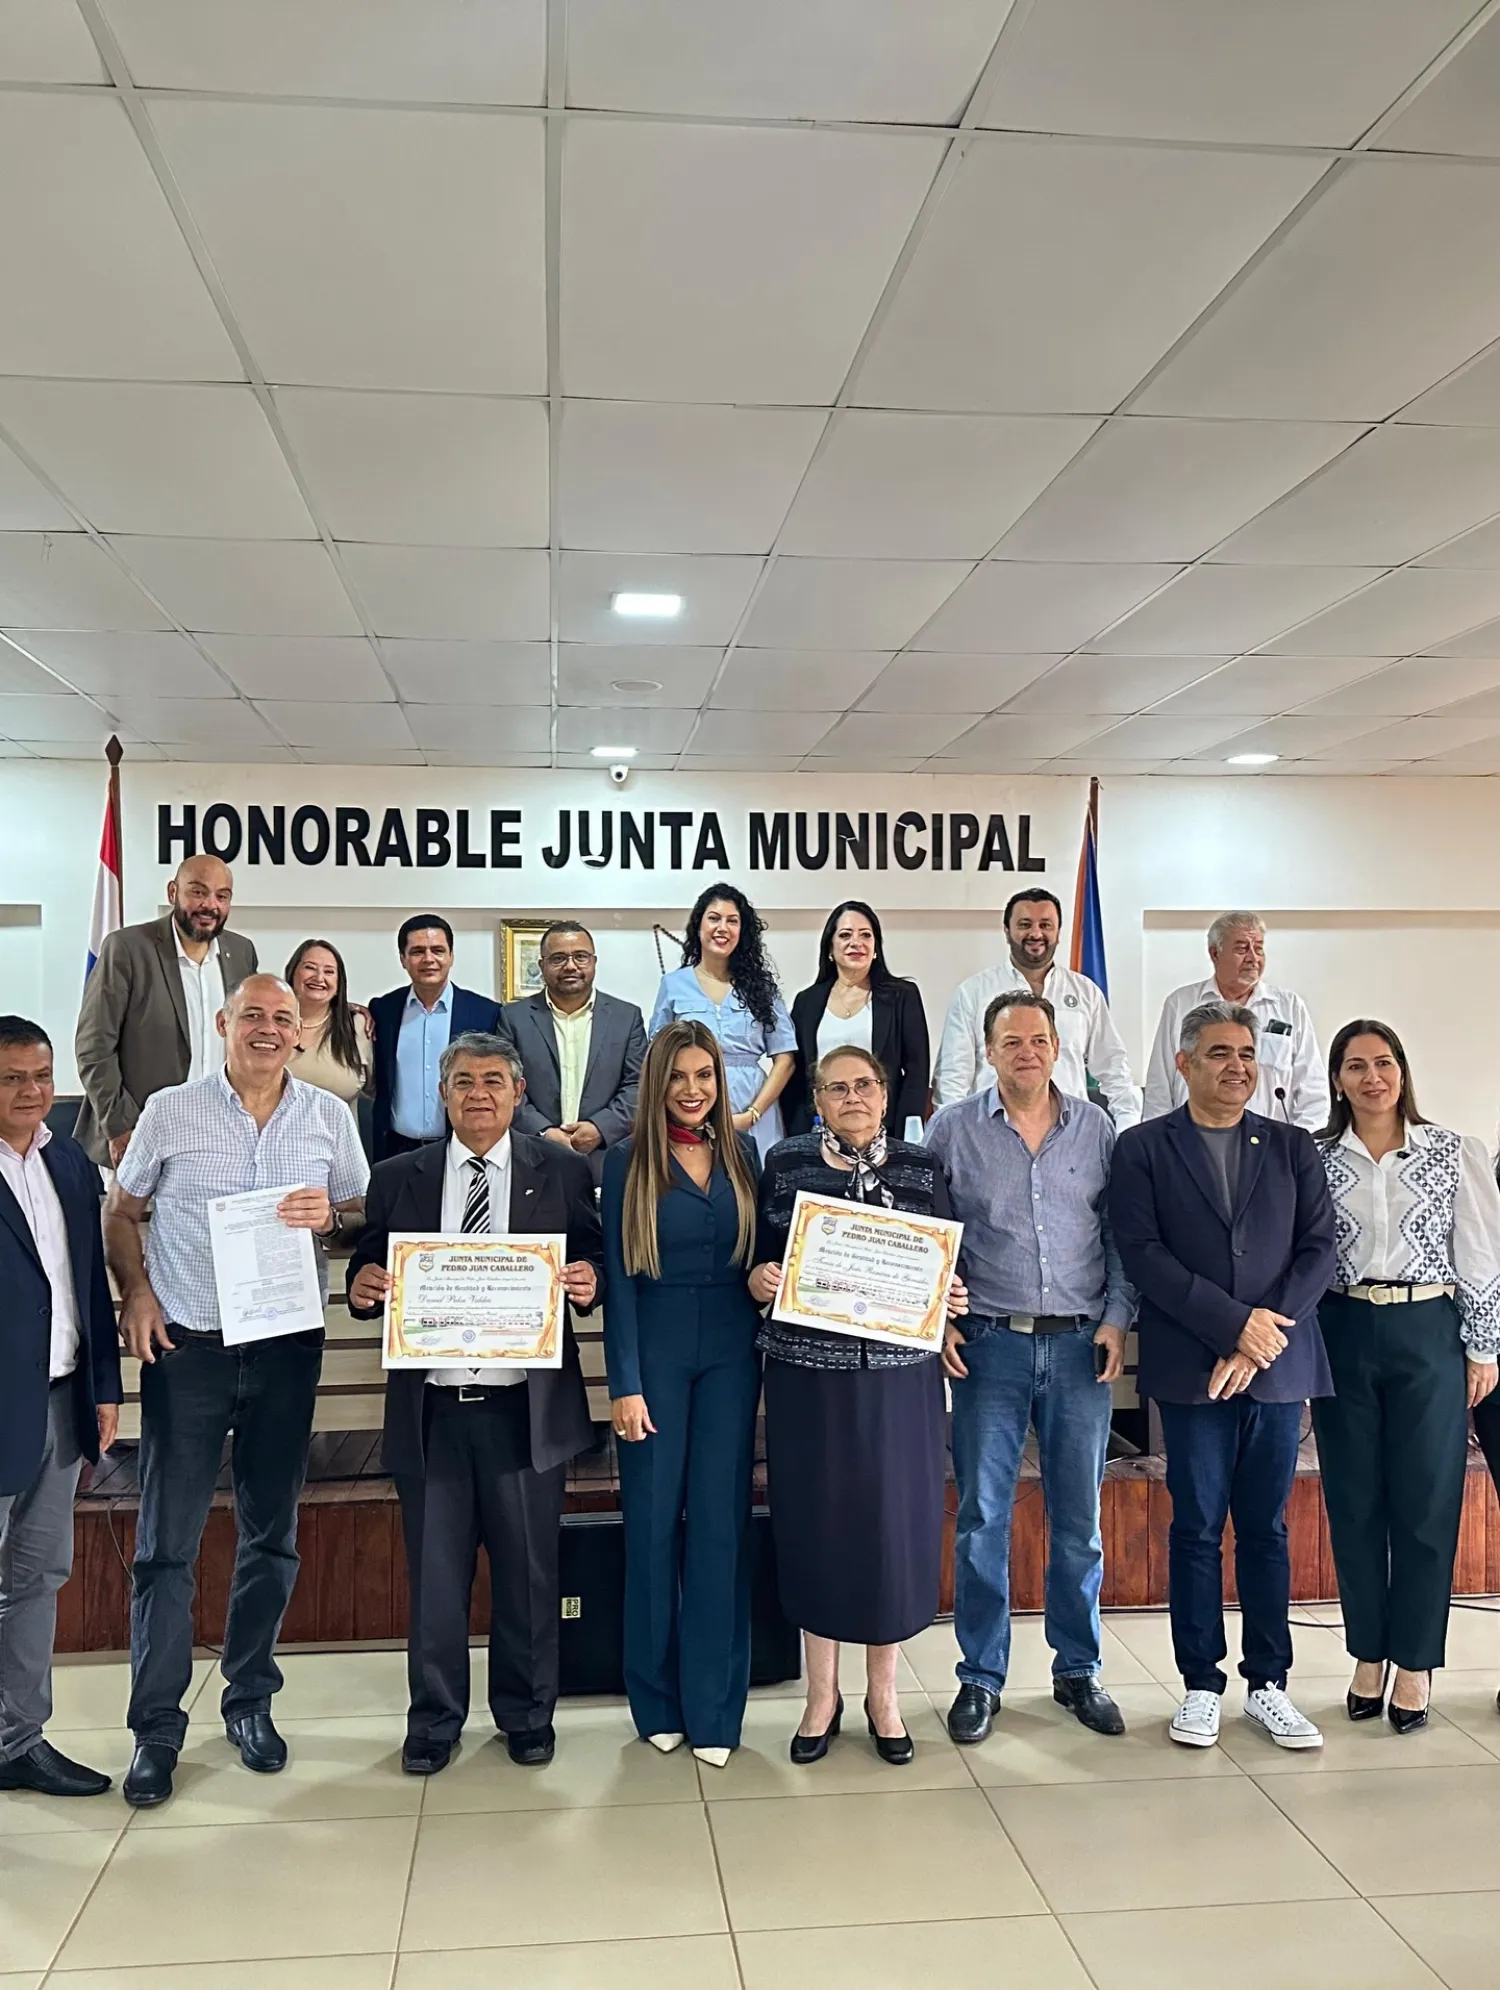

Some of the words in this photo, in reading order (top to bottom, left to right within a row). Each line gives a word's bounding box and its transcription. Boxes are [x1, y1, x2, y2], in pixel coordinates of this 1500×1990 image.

[157, 803, 522, 868] HONORABLE
[541, 809, 730, 869] JUNTA
[749, 811, 1046, 872] MUNICIPAL
[841, 1231, 867, 1242] PEDRO
[868, 1237, 886, 1246] JUAN
[887, 1240, 929, 1254] CABALLERO
[850, 1223, 873, 1234] JUNTA
[874, 1228, 911, 1242] MUNICIPAL
